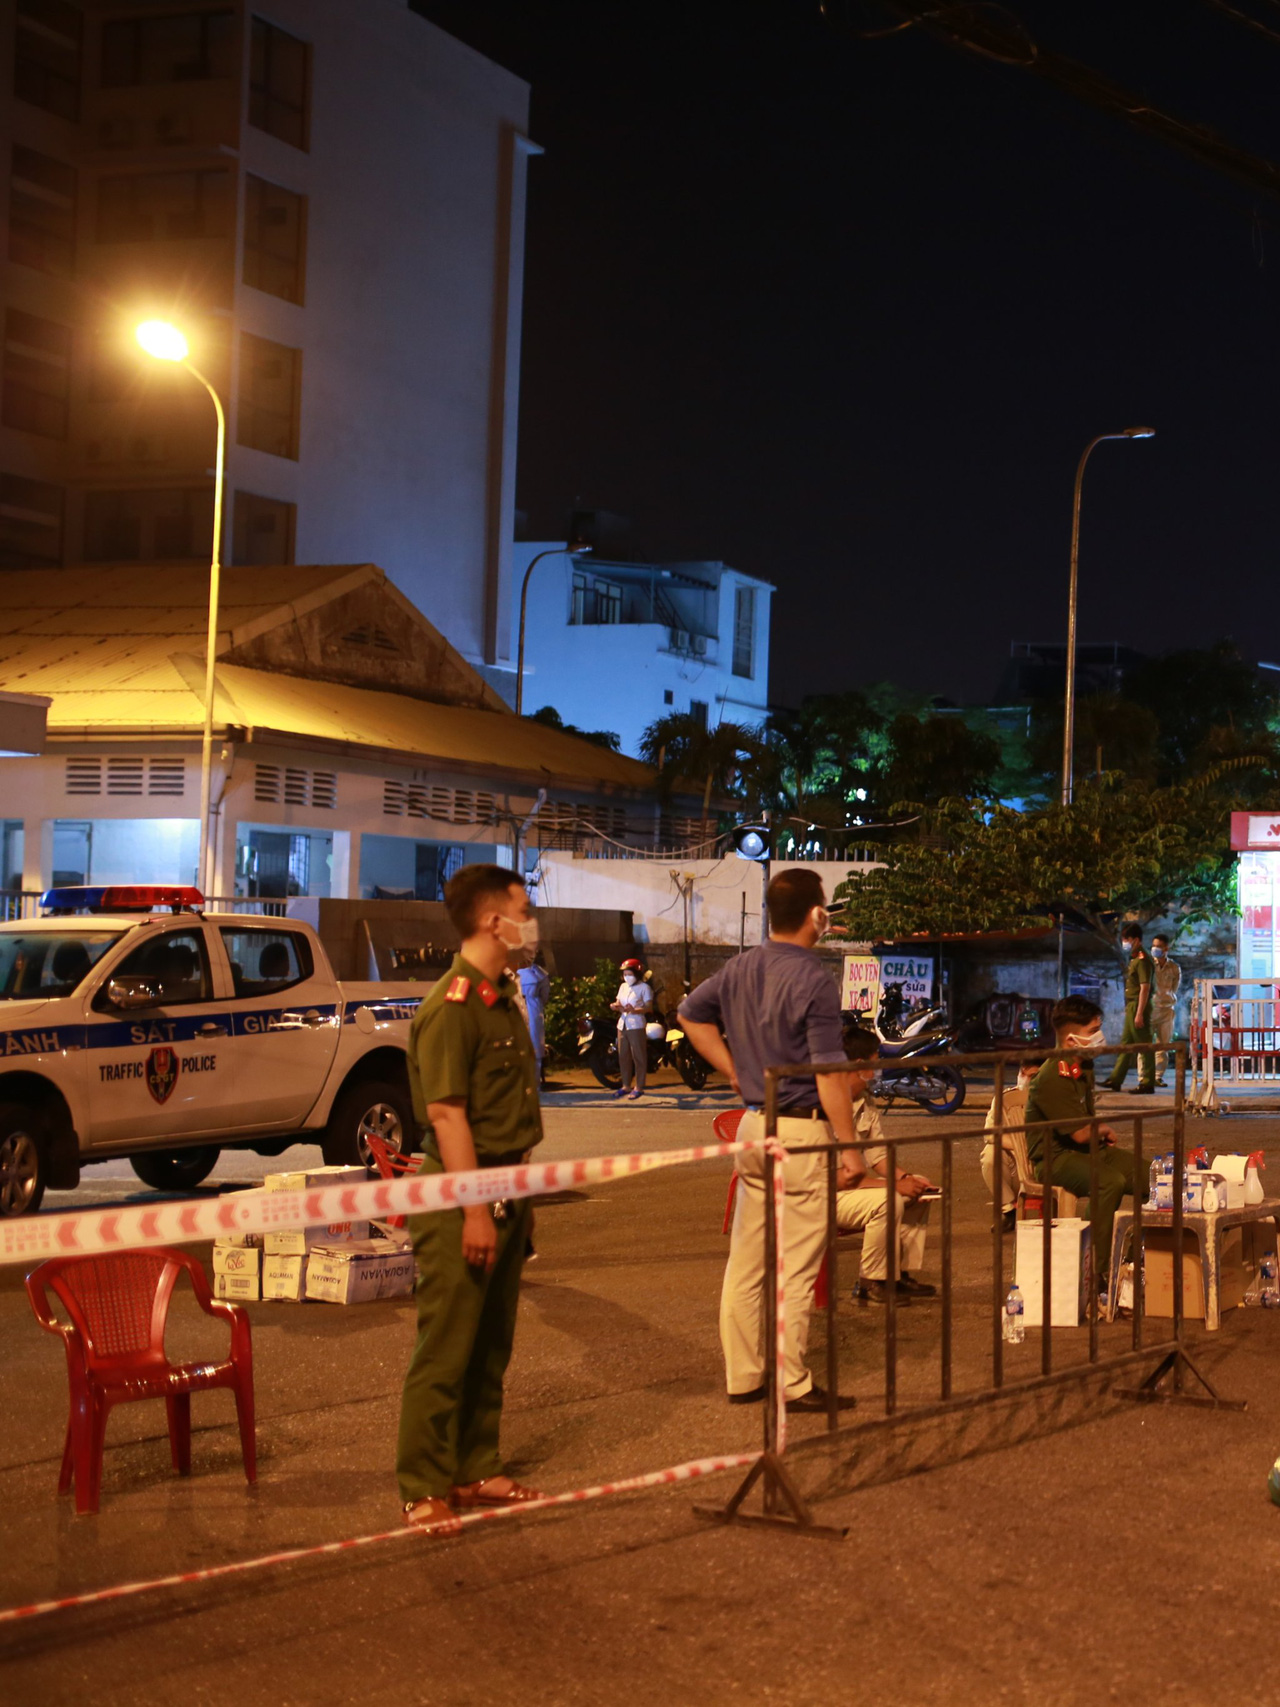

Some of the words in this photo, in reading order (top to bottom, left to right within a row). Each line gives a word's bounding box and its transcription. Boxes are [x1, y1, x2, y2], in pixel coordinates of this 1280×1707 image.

[883, 959, 928, 977] CHÂU
[0, 1031, 60, 1056] ẢNH
[99, 1062, 144, 1082] TRAFFIC
[182, 1055, 217, 1073] POLICE
[269, 1272, 293, 1280] AQUAMAN
[361, 1265, 411, 1281] AQUAMAN
